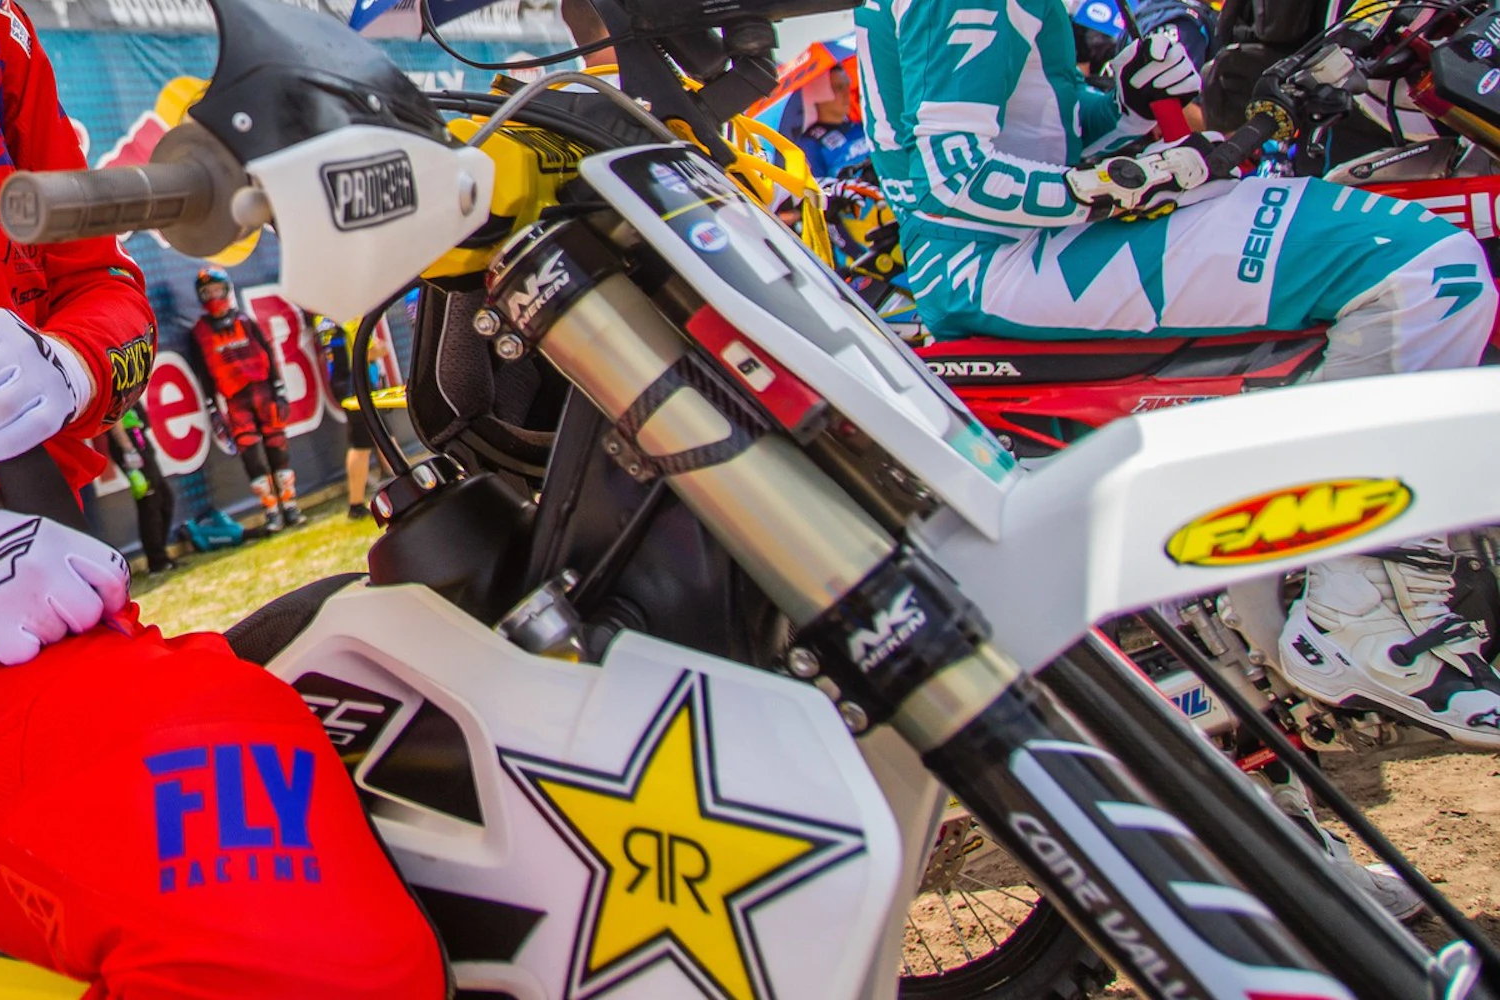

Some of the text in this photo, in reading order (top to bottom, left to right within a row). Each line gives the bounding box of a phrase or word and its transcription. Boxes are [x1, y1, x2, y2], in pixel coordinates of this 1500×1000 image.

[1237, 186, 1289, 283] GEICO
[518, 272, 572, 330] NEKEN
[1180, 478, 1404, 562] FMF
[860, 608, 927, 674] NEKEN
[143, 744, 316, 863] FLY
[159, 854, 321, 894] RACING
